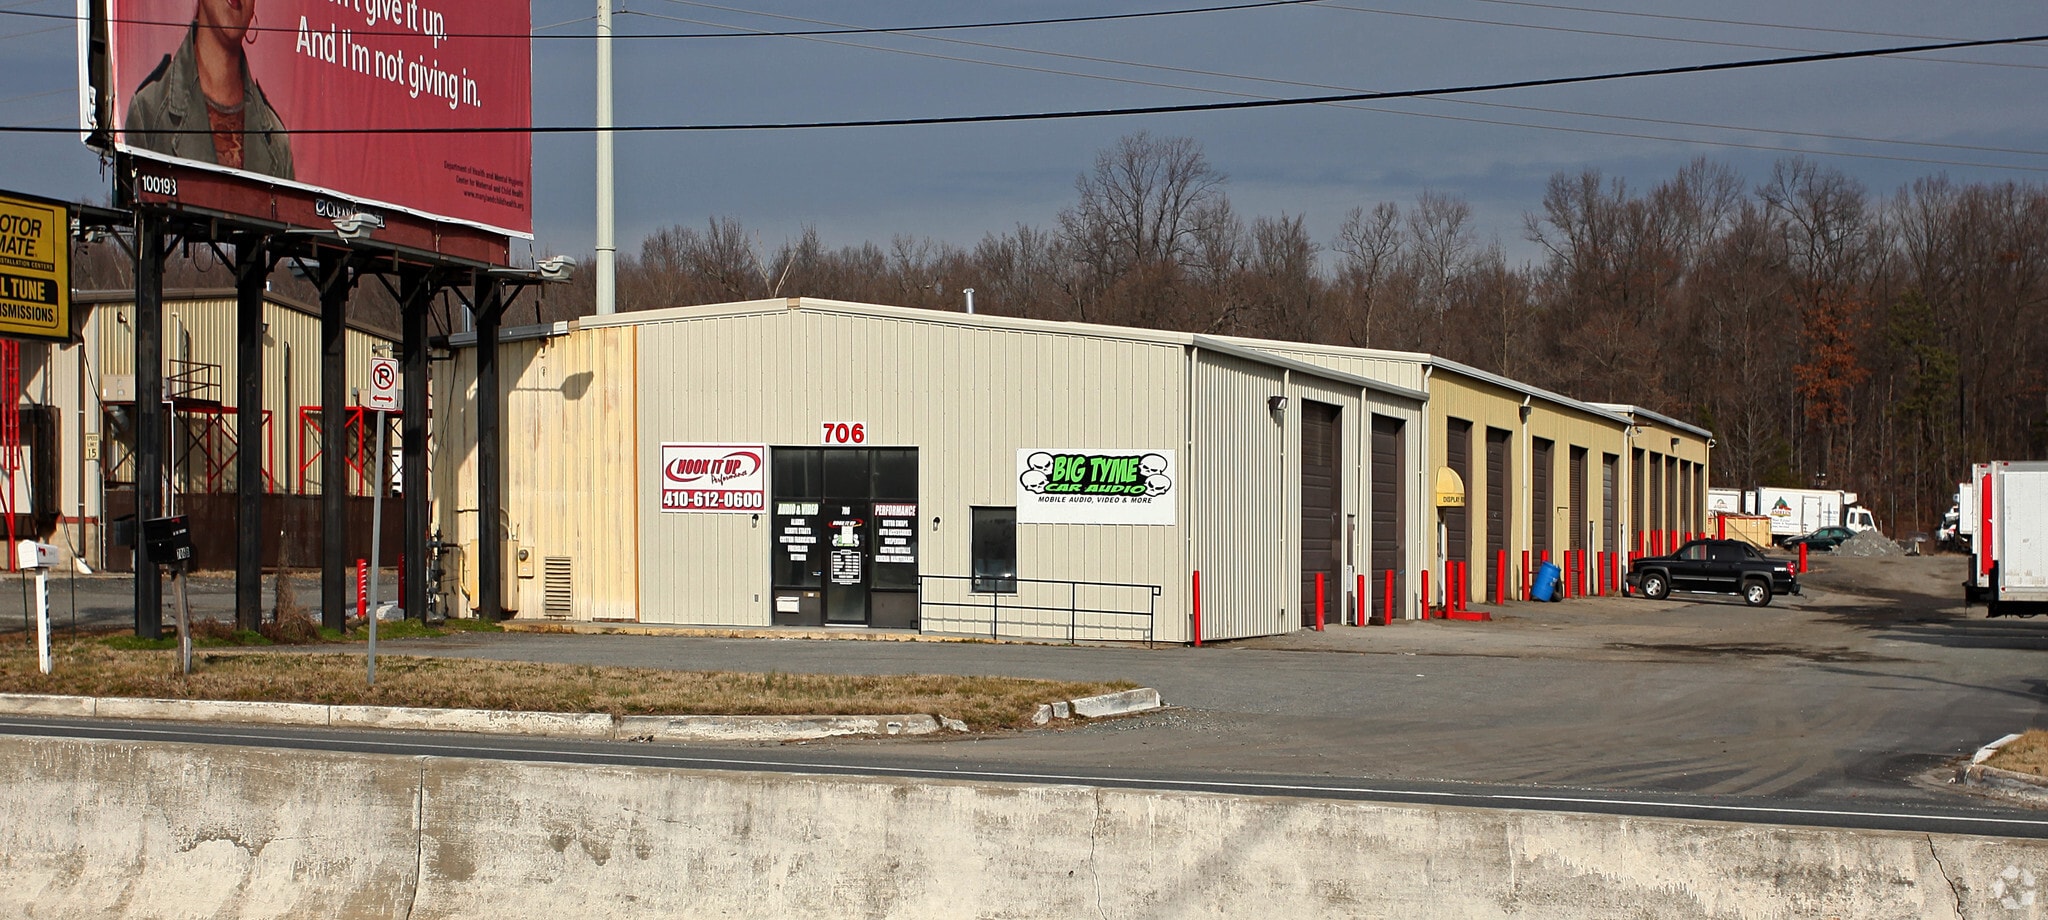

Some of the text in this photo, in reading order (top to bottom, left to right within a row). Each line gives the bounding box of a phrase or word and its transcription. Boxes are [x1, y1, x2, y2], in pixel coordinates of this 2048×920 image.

[407, 0, 418, 31] it
[422, 8, 448, 49] up.
[296, 15, 482, 110] And I'm not giving in.
[142, 175, 177, 196] 100193
[11, 278, 45, 301] TUNE
[0, 302, 53, 322] SMISSIONS
[823, 423, 865, 443] 706
[88, 448, 97, 458] 15
[676, 459, 742, 475] HOOK IT UP
[1052, 456, 1139, 484] BIG TYME
[1044, 483, 1147, 494] CAR AUDIO
[663, 491, 763, 508] 410-612-0600
[1068, 496, 1094, 504] AUDIO,
[777, 503, 797, 516] AUDIO
[801, 503, 819, 516] VIDEO
[874, 504, 917, 517] PERFORMANCE
